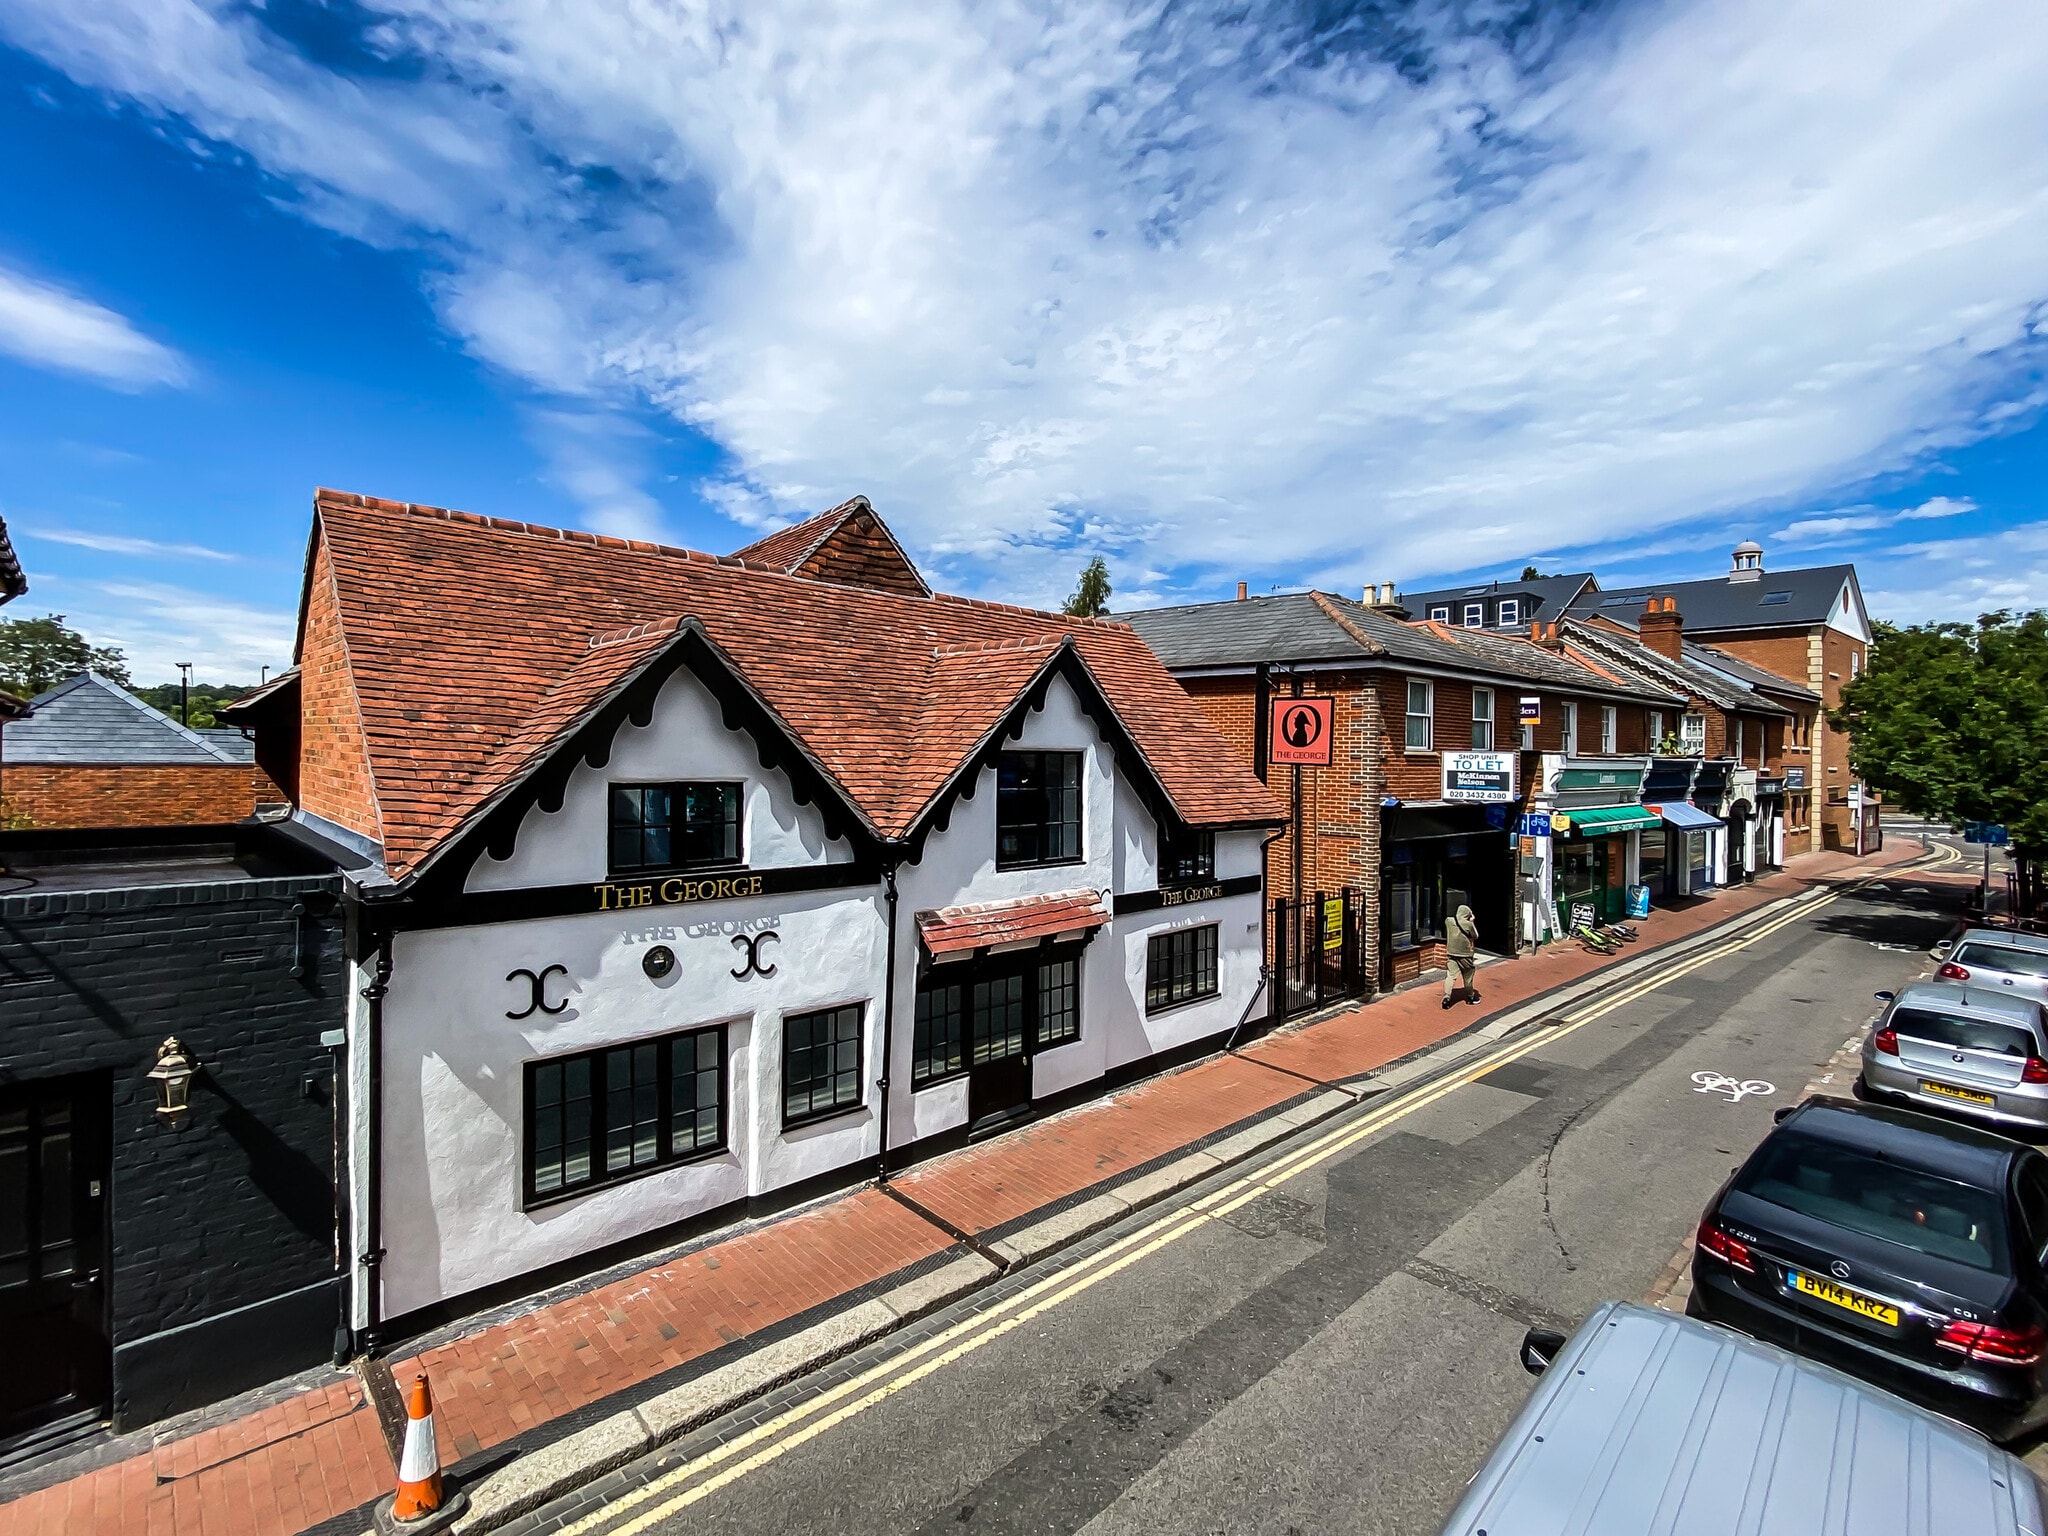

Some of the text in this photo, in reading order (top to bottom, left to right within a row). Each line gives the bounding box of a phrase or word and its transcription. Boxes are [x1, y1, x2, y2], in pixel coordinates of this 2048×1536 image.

[1276, 751, 1327, 760] THE GEORGE
[1453, 760, 1504, 771] TO LET
[1457, 778, 1486, 786] Nelson
[1449, 790, 1507, 800] 020 3432 4300
[594, 876, 763, 910] THE GEORGE
[1160, 885, 1223, 906] THE GEORGE
[1804, 1276, 1889, 1319] BV14 KRZ
